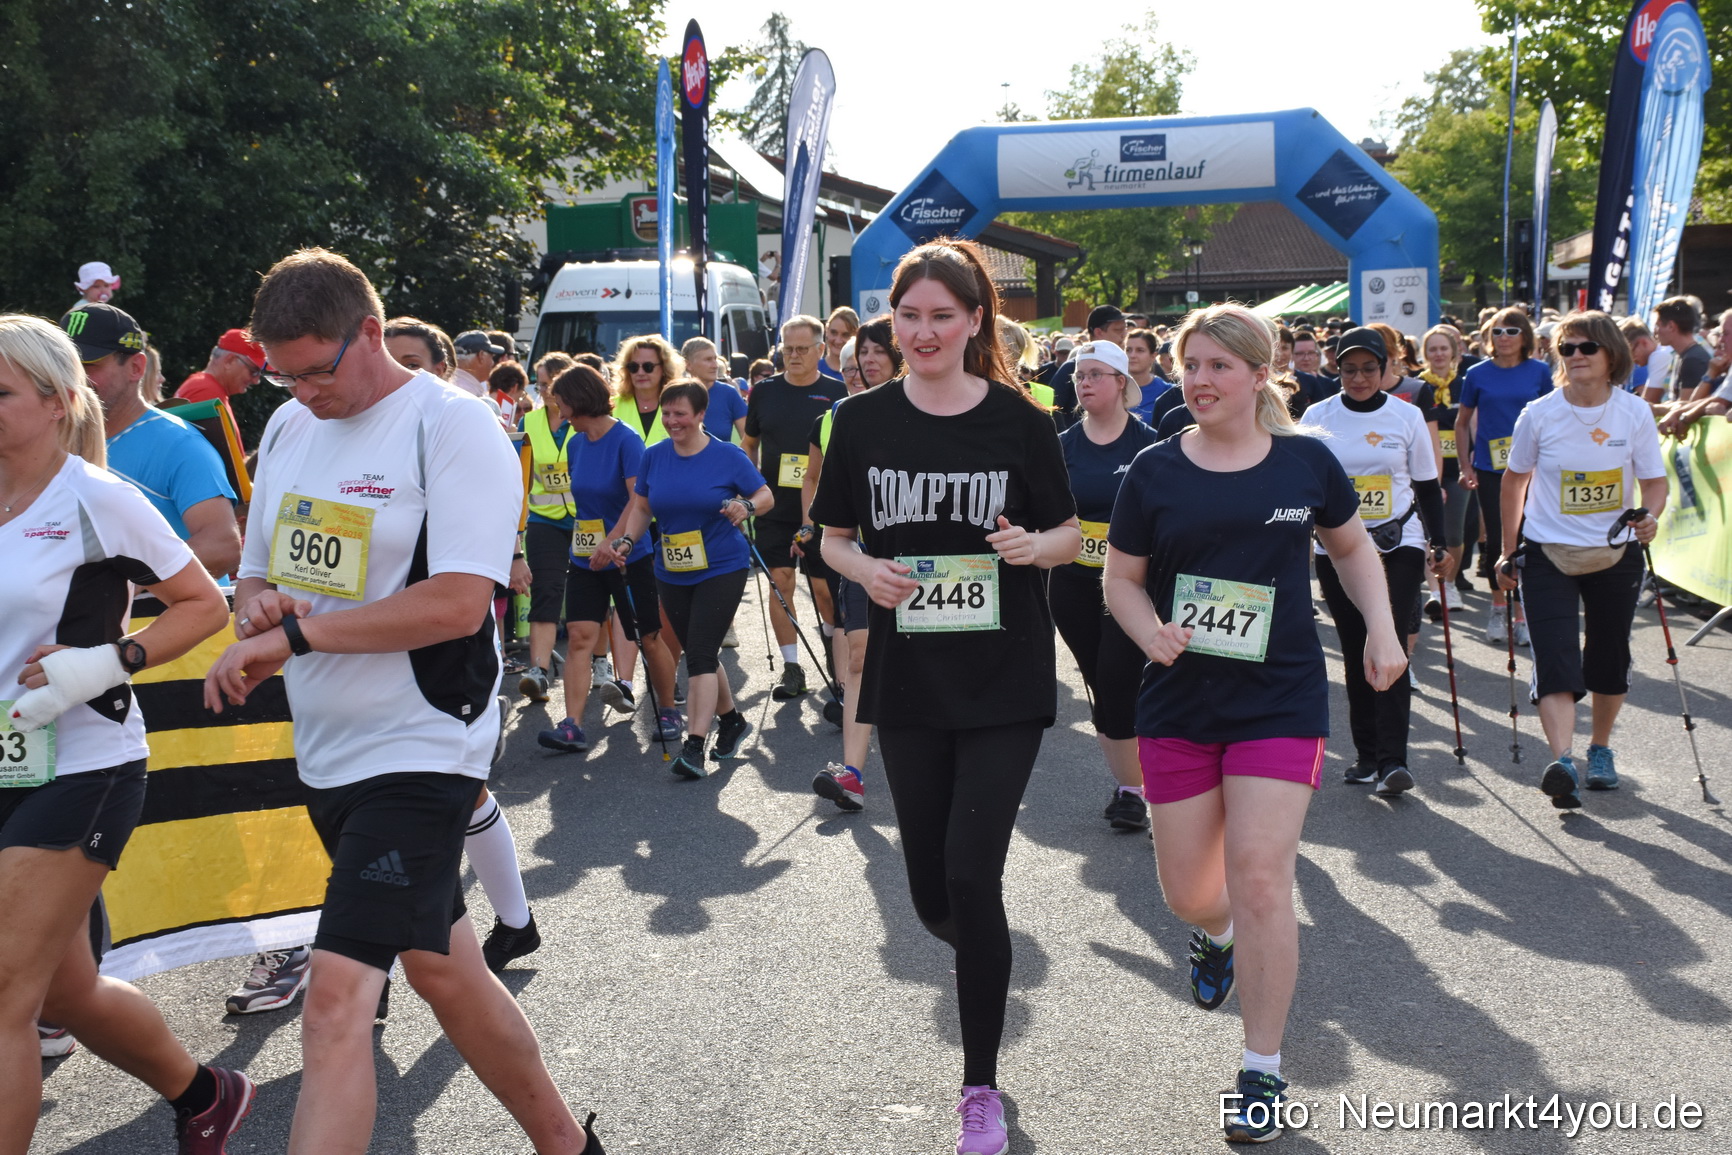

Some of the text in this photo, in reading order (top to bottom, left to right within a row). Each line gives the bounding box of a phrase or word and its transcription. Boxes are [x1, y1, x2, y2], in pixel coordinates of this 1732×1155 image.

[1635, 12, 1657, 47] He
[806, 73, 822, 153] scher
[1104, 159, 1207, 183] firmenlauf
[1104, 183, 1146, 191] neumarkt
[911, 206, 965, 218] Fischer
[555, 288, 598, 298] abavent
[1440, 440, 1456, 450] 28
[338, 480, 376, 488] guttenberger
[362, 473, 384, 481] TEAM
[545, 472, 571, 485] 151
[346, 486, 395, 495] partner
[1569, 484, 1616, 503] 1337
[868, 466, 1008, 531] COMPTON
[289, 511, 323, 526] firmenlauf
[1265, 508, 1304, 525] JURA
[30, 530, 70, 538] partner
[343, 530, 363, 540] 2019
[575, 533, 596, 546] 862
[289, 528, 342, 570] 960
[667, 546, 693, 561] 854
[295, 563, 332, 579] Kerl Oliver
[909, 569, 950, 579] firmenlauf
[281, 571, 309, 582] guttenberger
[310, 577, 328, 587] partner
[328, 580, 345, 588] GmbH
[908, 582, 985, 611] 2448
[1187, 590, 1225, 603] firmenlauf
[1247, 604, 1267, 613] 2019
[1181, 603, 1257, 638] 2447
[0, 732, 27, 763] 3
[360, 868, 410, 886] adidas
